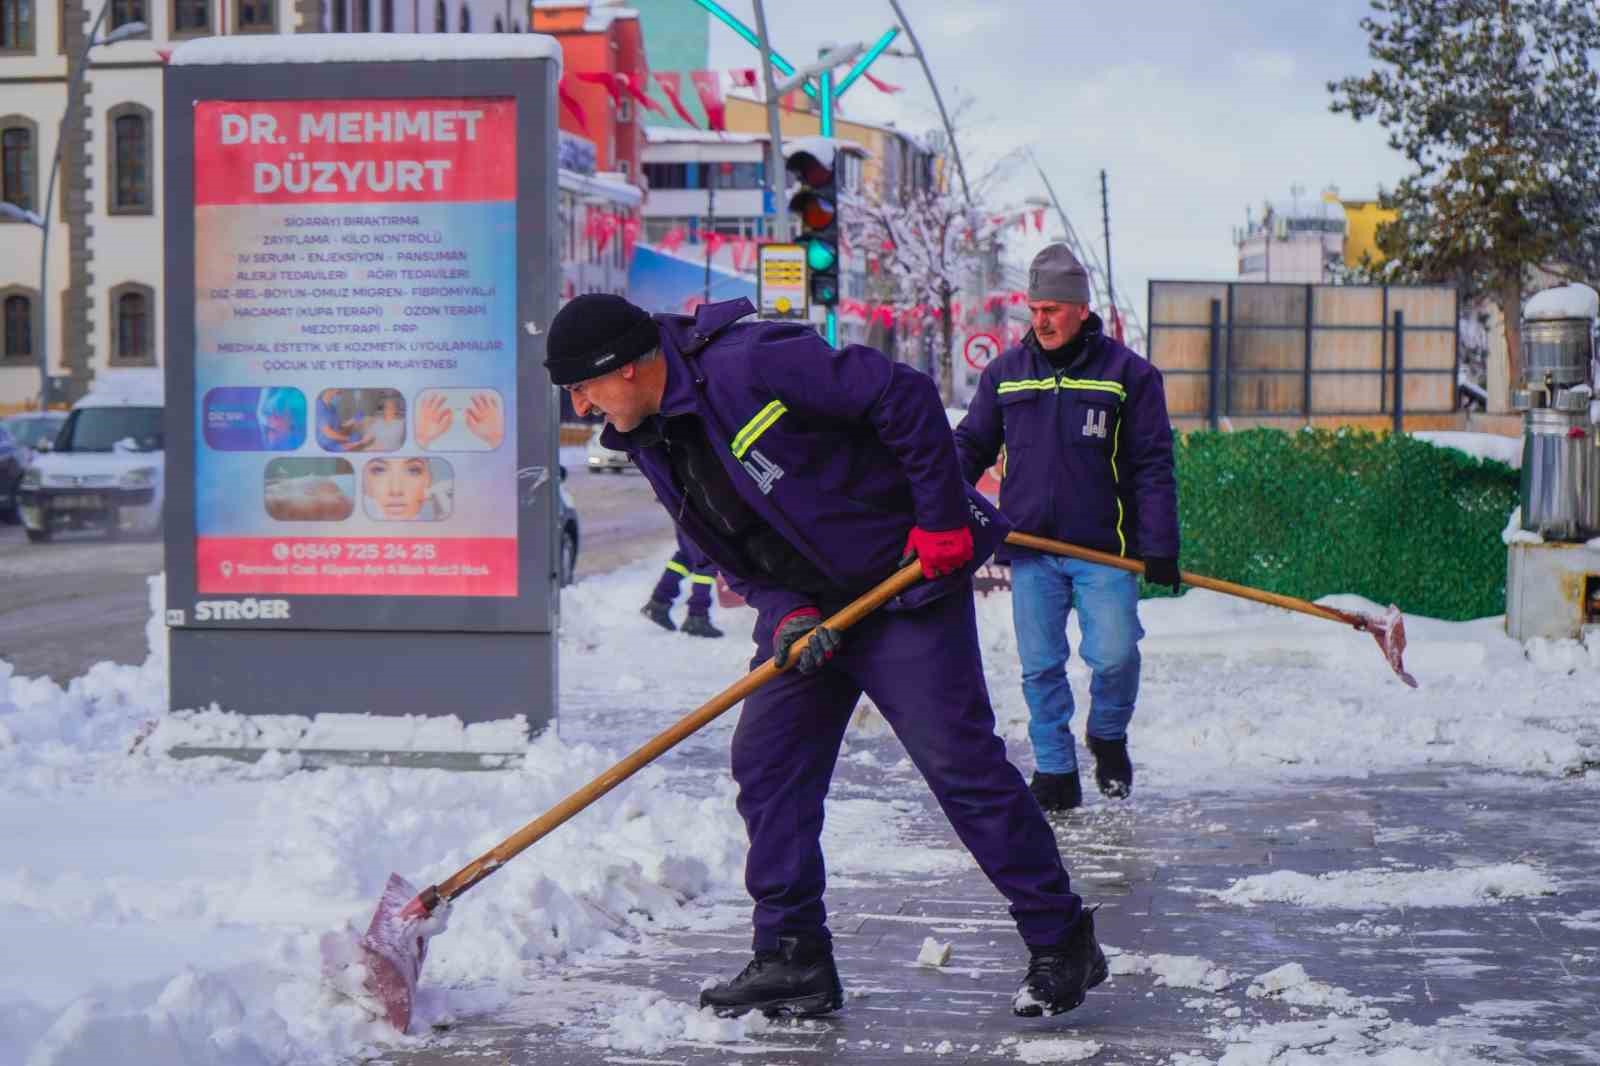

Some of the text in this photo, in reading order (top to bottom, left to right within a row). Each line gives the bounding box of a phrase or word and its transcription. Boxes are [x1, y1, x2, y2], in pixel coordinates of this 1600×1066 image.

[221, 109, 483, 145] DR. MEHMET
[253, 153, 453, 194] DÜZYURT
[402, 305, 441, 317] OZON
[324, 343, 340, 353] VE
[310, 360, 327, 370] VE
[347, 543, 380, 560] 725
[383, 543, 407, 560] 24
[411, 543, 437, 560] 25
[194, 597, 291, 621] STRÖER
